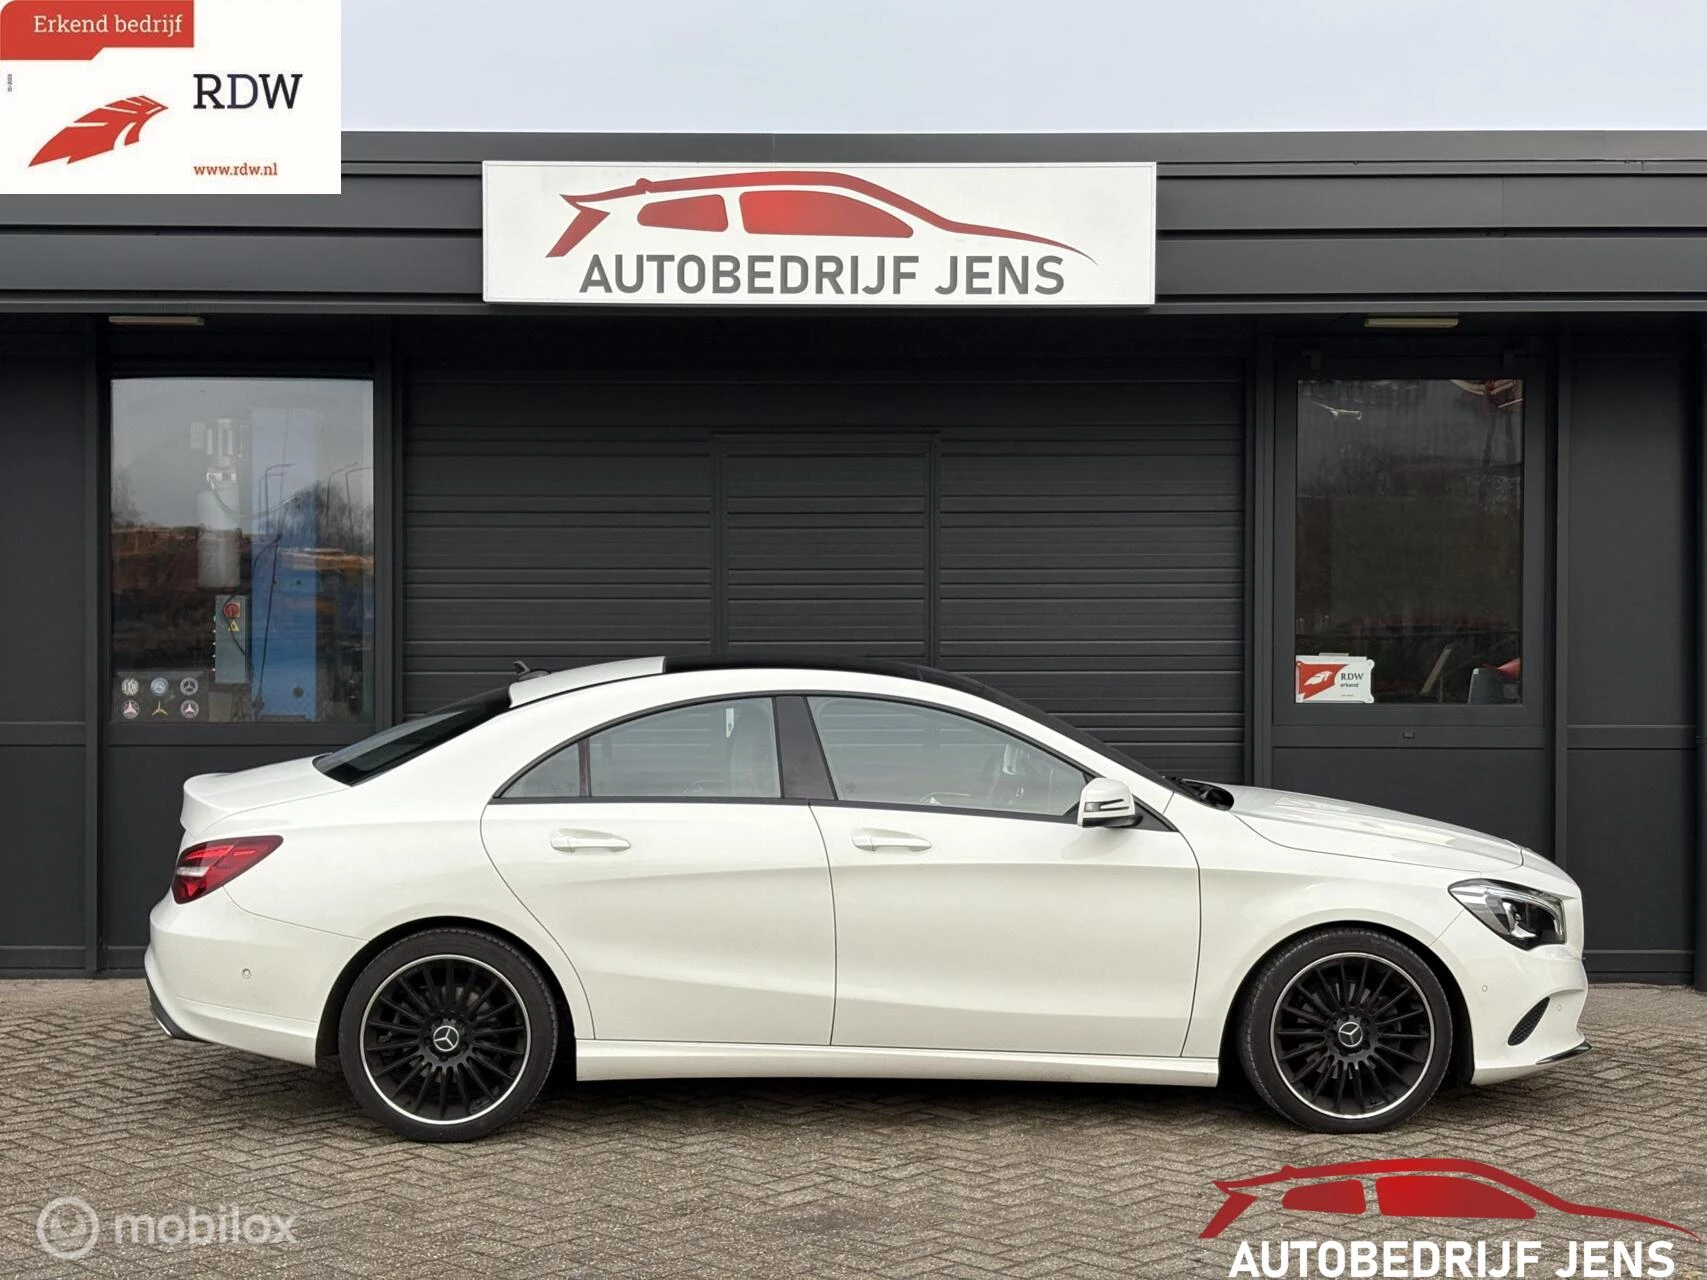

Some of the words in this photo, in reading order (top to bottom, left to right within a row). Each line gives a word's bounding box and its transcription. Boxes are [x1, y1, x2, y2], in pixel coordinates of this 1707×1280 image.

[579, 254, 920, 296] AUTOBEDRIJF
[934, 254, 1065, 296] JENS
[1340, 672, 1364, 681] RDW
